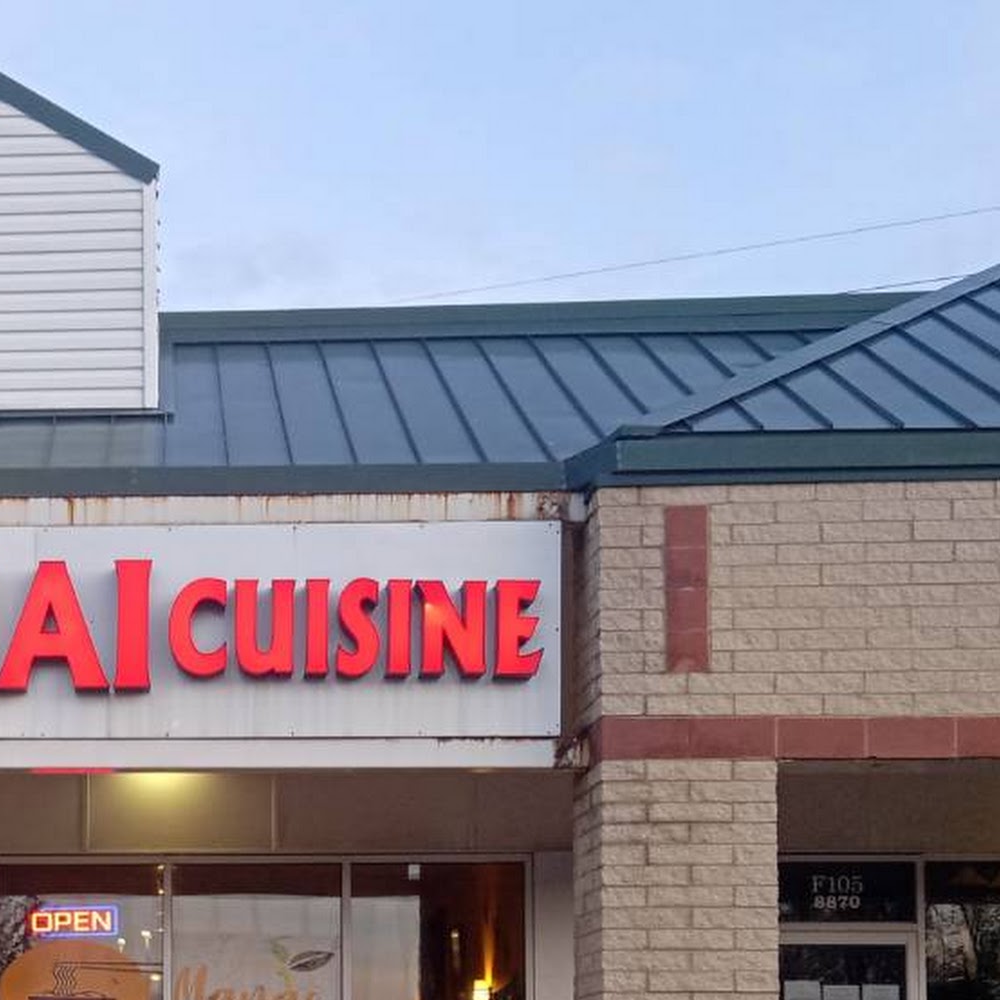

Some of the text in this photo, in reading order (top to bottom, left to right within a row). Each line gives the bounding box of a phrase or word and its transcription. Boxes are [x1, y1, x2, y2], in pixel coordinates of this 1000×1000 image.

[168, 576, 544, 681] CUISINE
[812, 875, 863, 893] F105
[813, 895, 861, 909] 8870
[31, 910, 112, 932] OPEN
